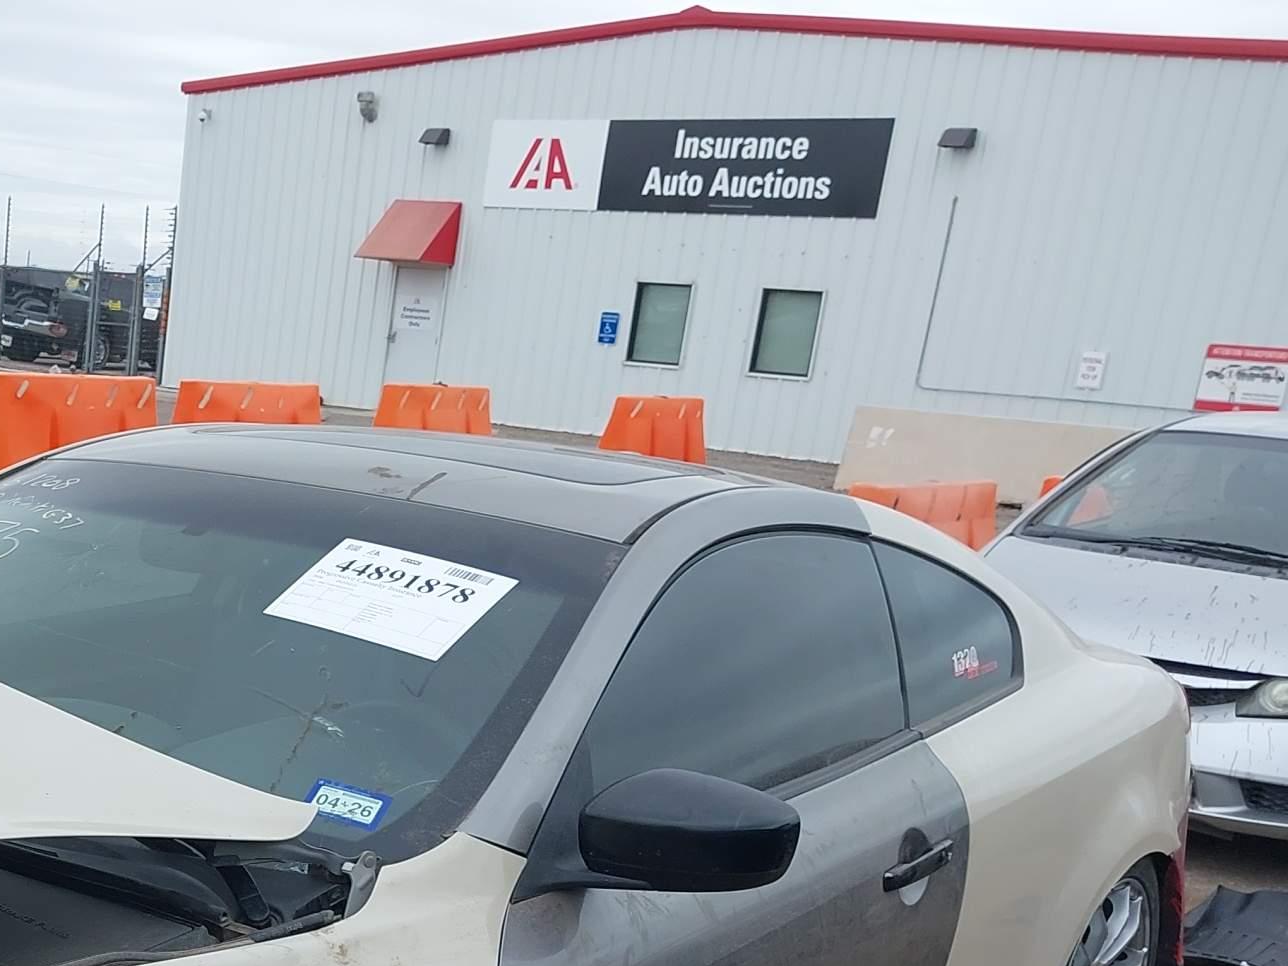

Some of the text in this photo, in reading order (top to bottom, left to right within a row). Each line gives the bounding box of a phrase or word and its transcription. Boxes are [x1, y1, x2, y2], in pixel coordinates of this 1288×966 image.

[674, 128, 809, 161] Insurance
[641, 167, 831, 200] Auto Auctions
[335, 559, 476, 604] 44891878
[315, 793, 340, 809] 04
[347, 802, 374, 818] 26
